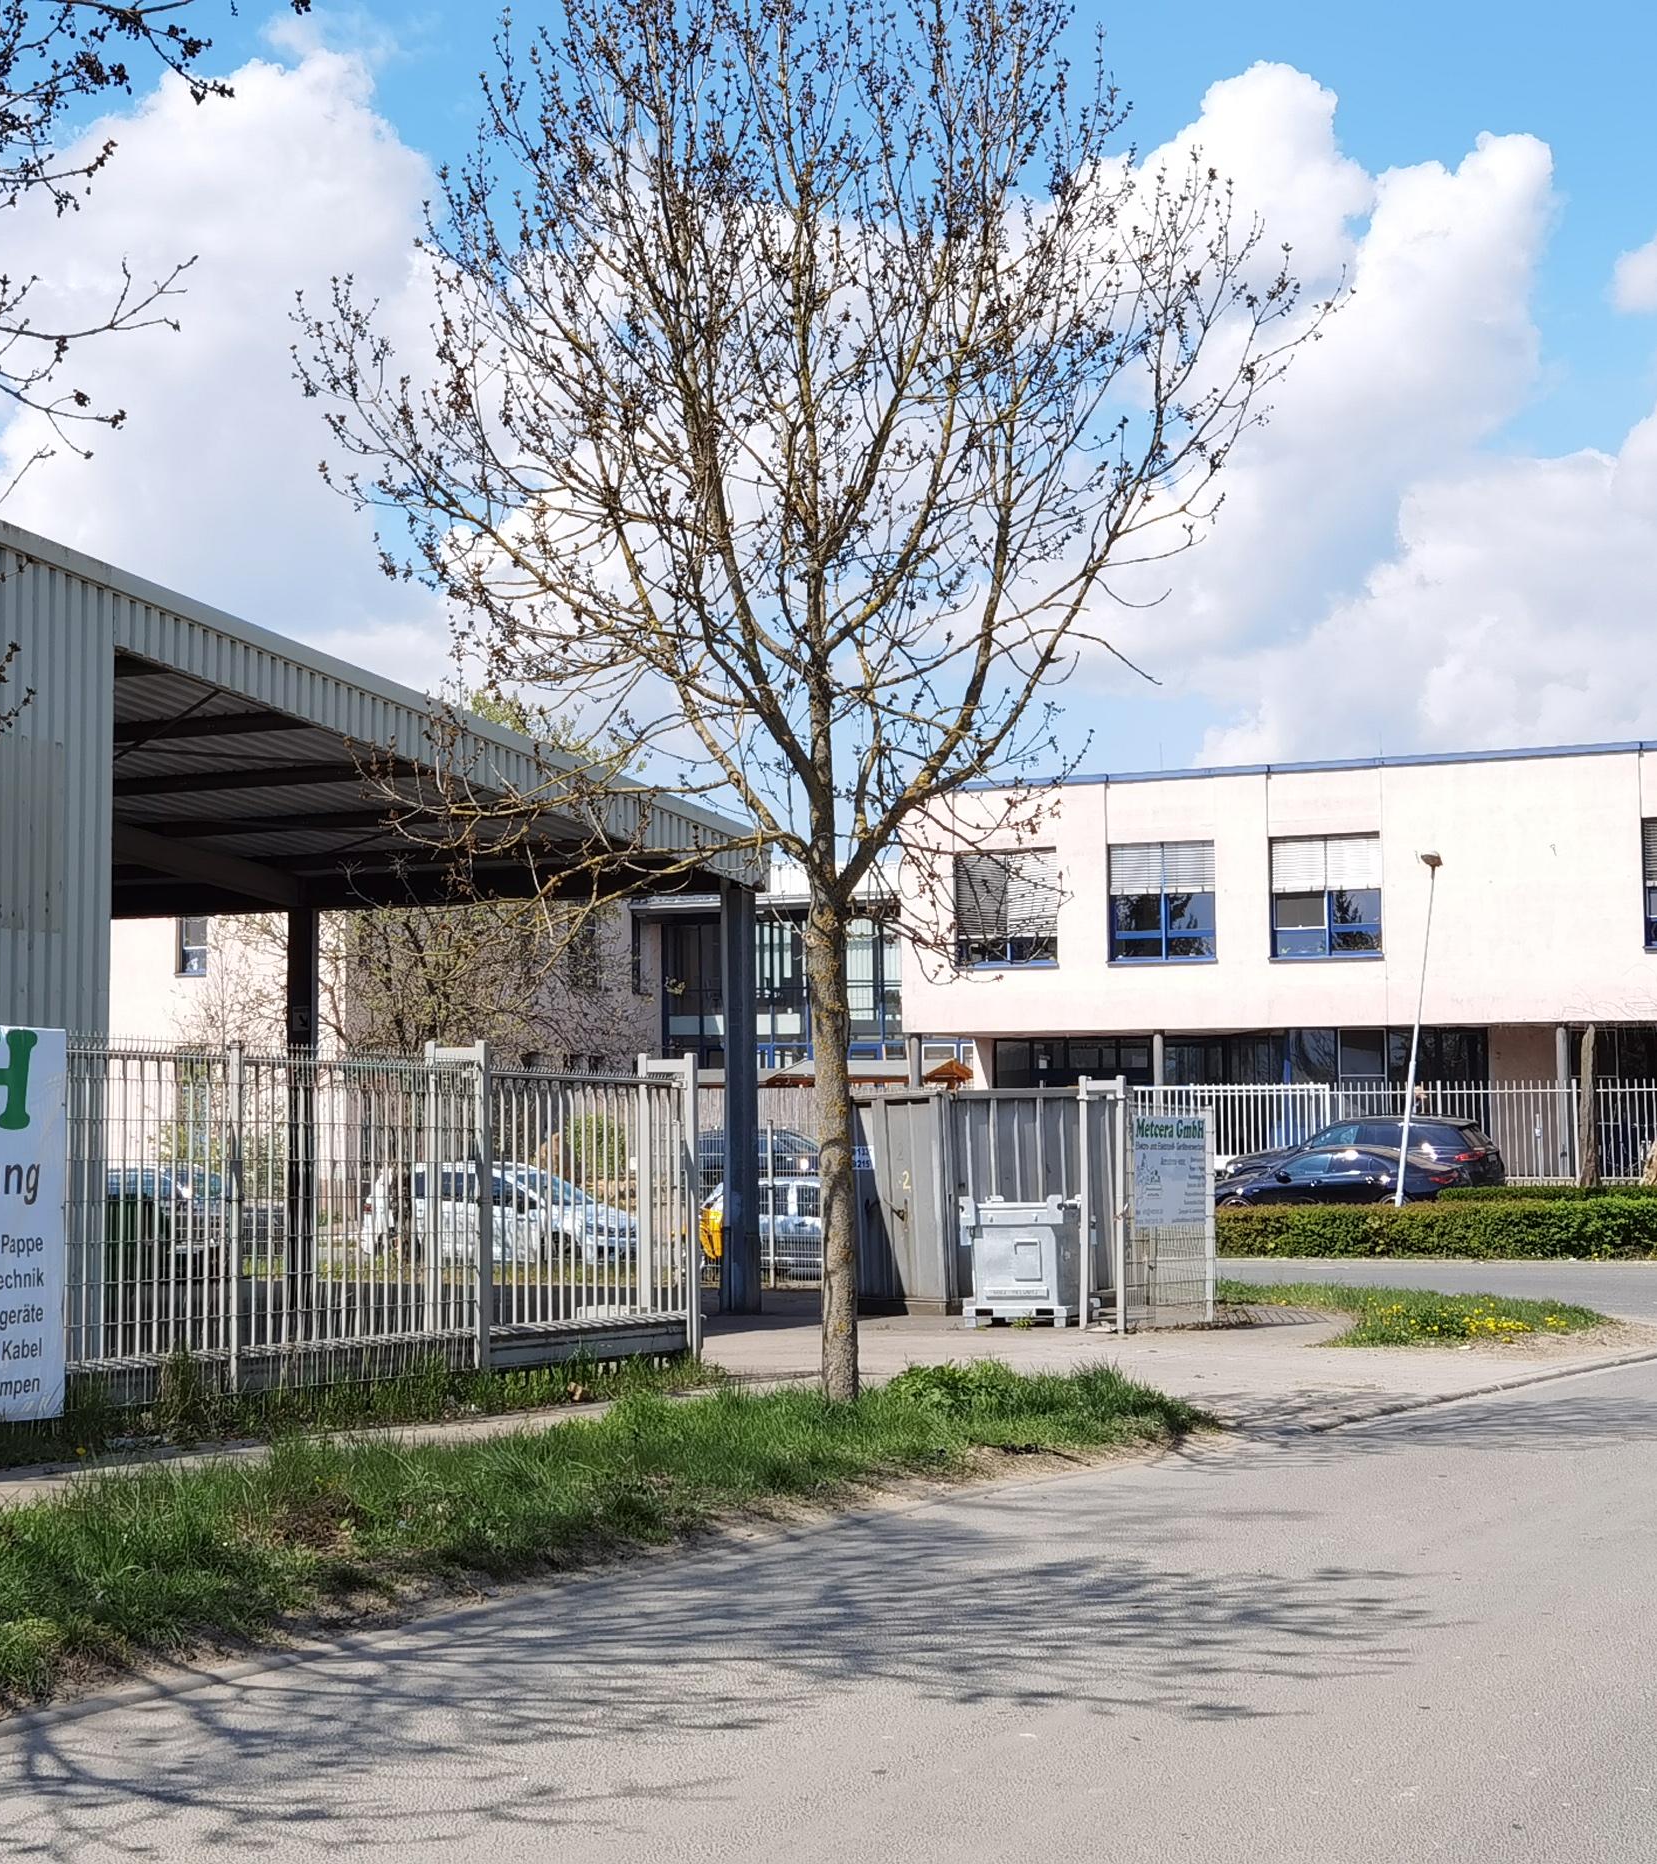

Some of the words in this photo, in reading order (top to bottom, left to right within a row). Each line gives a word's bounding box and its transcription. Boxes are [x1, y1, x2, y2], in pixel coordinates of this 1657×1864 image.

[1136, 1118, 1174, 1138] Metcera
[1176, 1119, 1205, 1139] GmbH
[902, 1170, 912, 1191] 2
[1, 1235, 44, 1258] Pappe
[2, 1338, 42, 1361] Kabel
